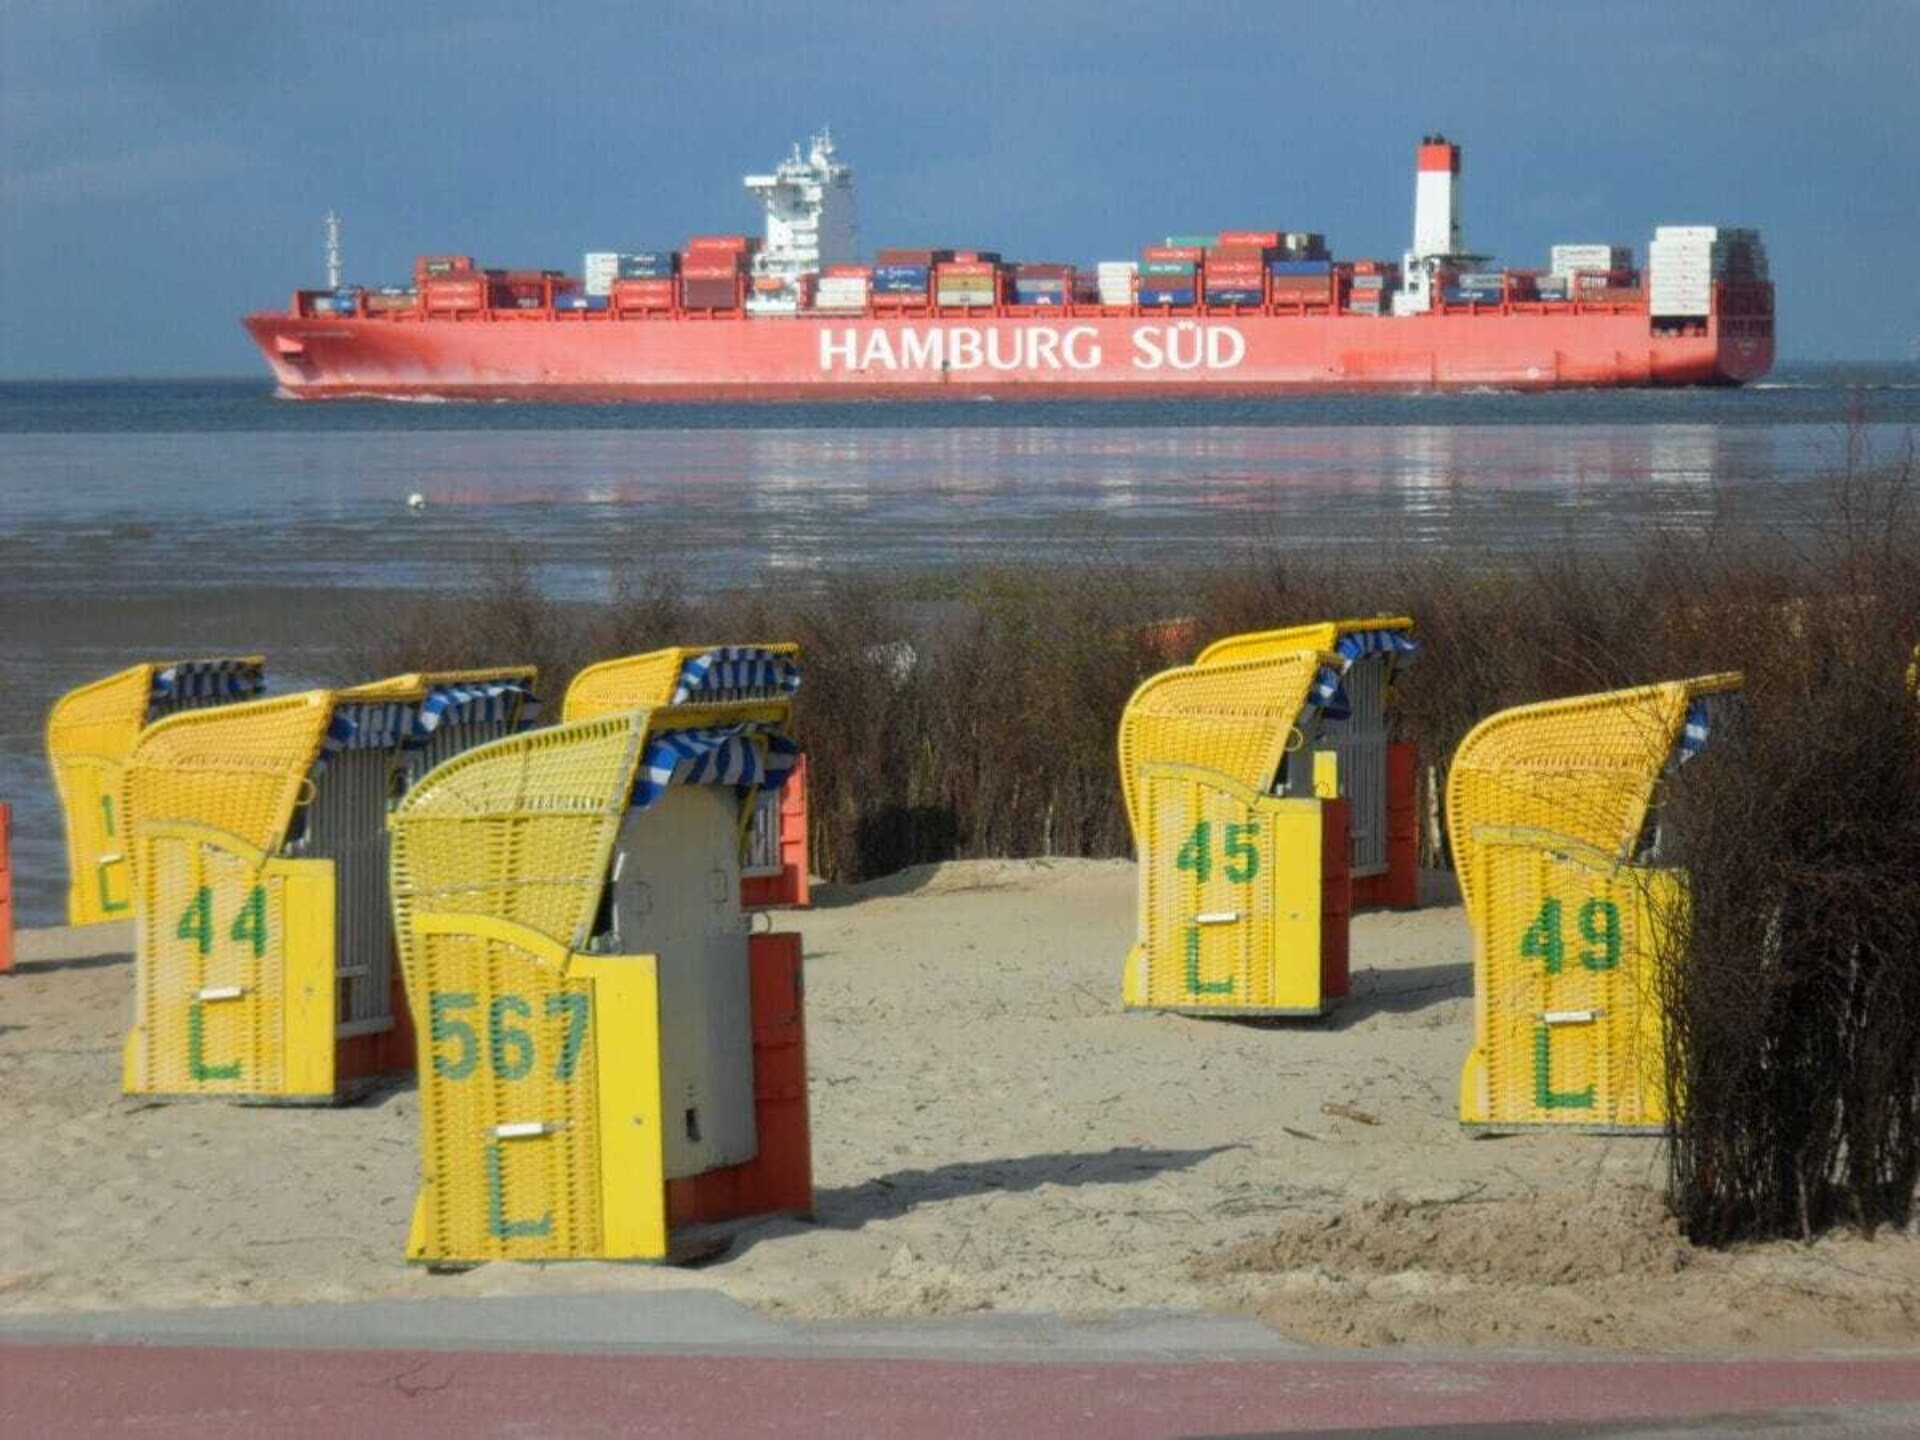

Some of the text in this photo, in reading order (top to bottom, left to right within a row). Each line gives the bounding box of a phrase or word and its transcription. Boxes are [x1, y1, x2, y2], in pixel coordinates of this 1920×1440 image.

[818, 319, 1246, 371] HAMBURG SÜD
[1176, 820, 1261, 884] 45
[176, 885, 268, 956] 44
[1519, 895, 1623, 975] 49
[428, 990, 591, 1083] 567
